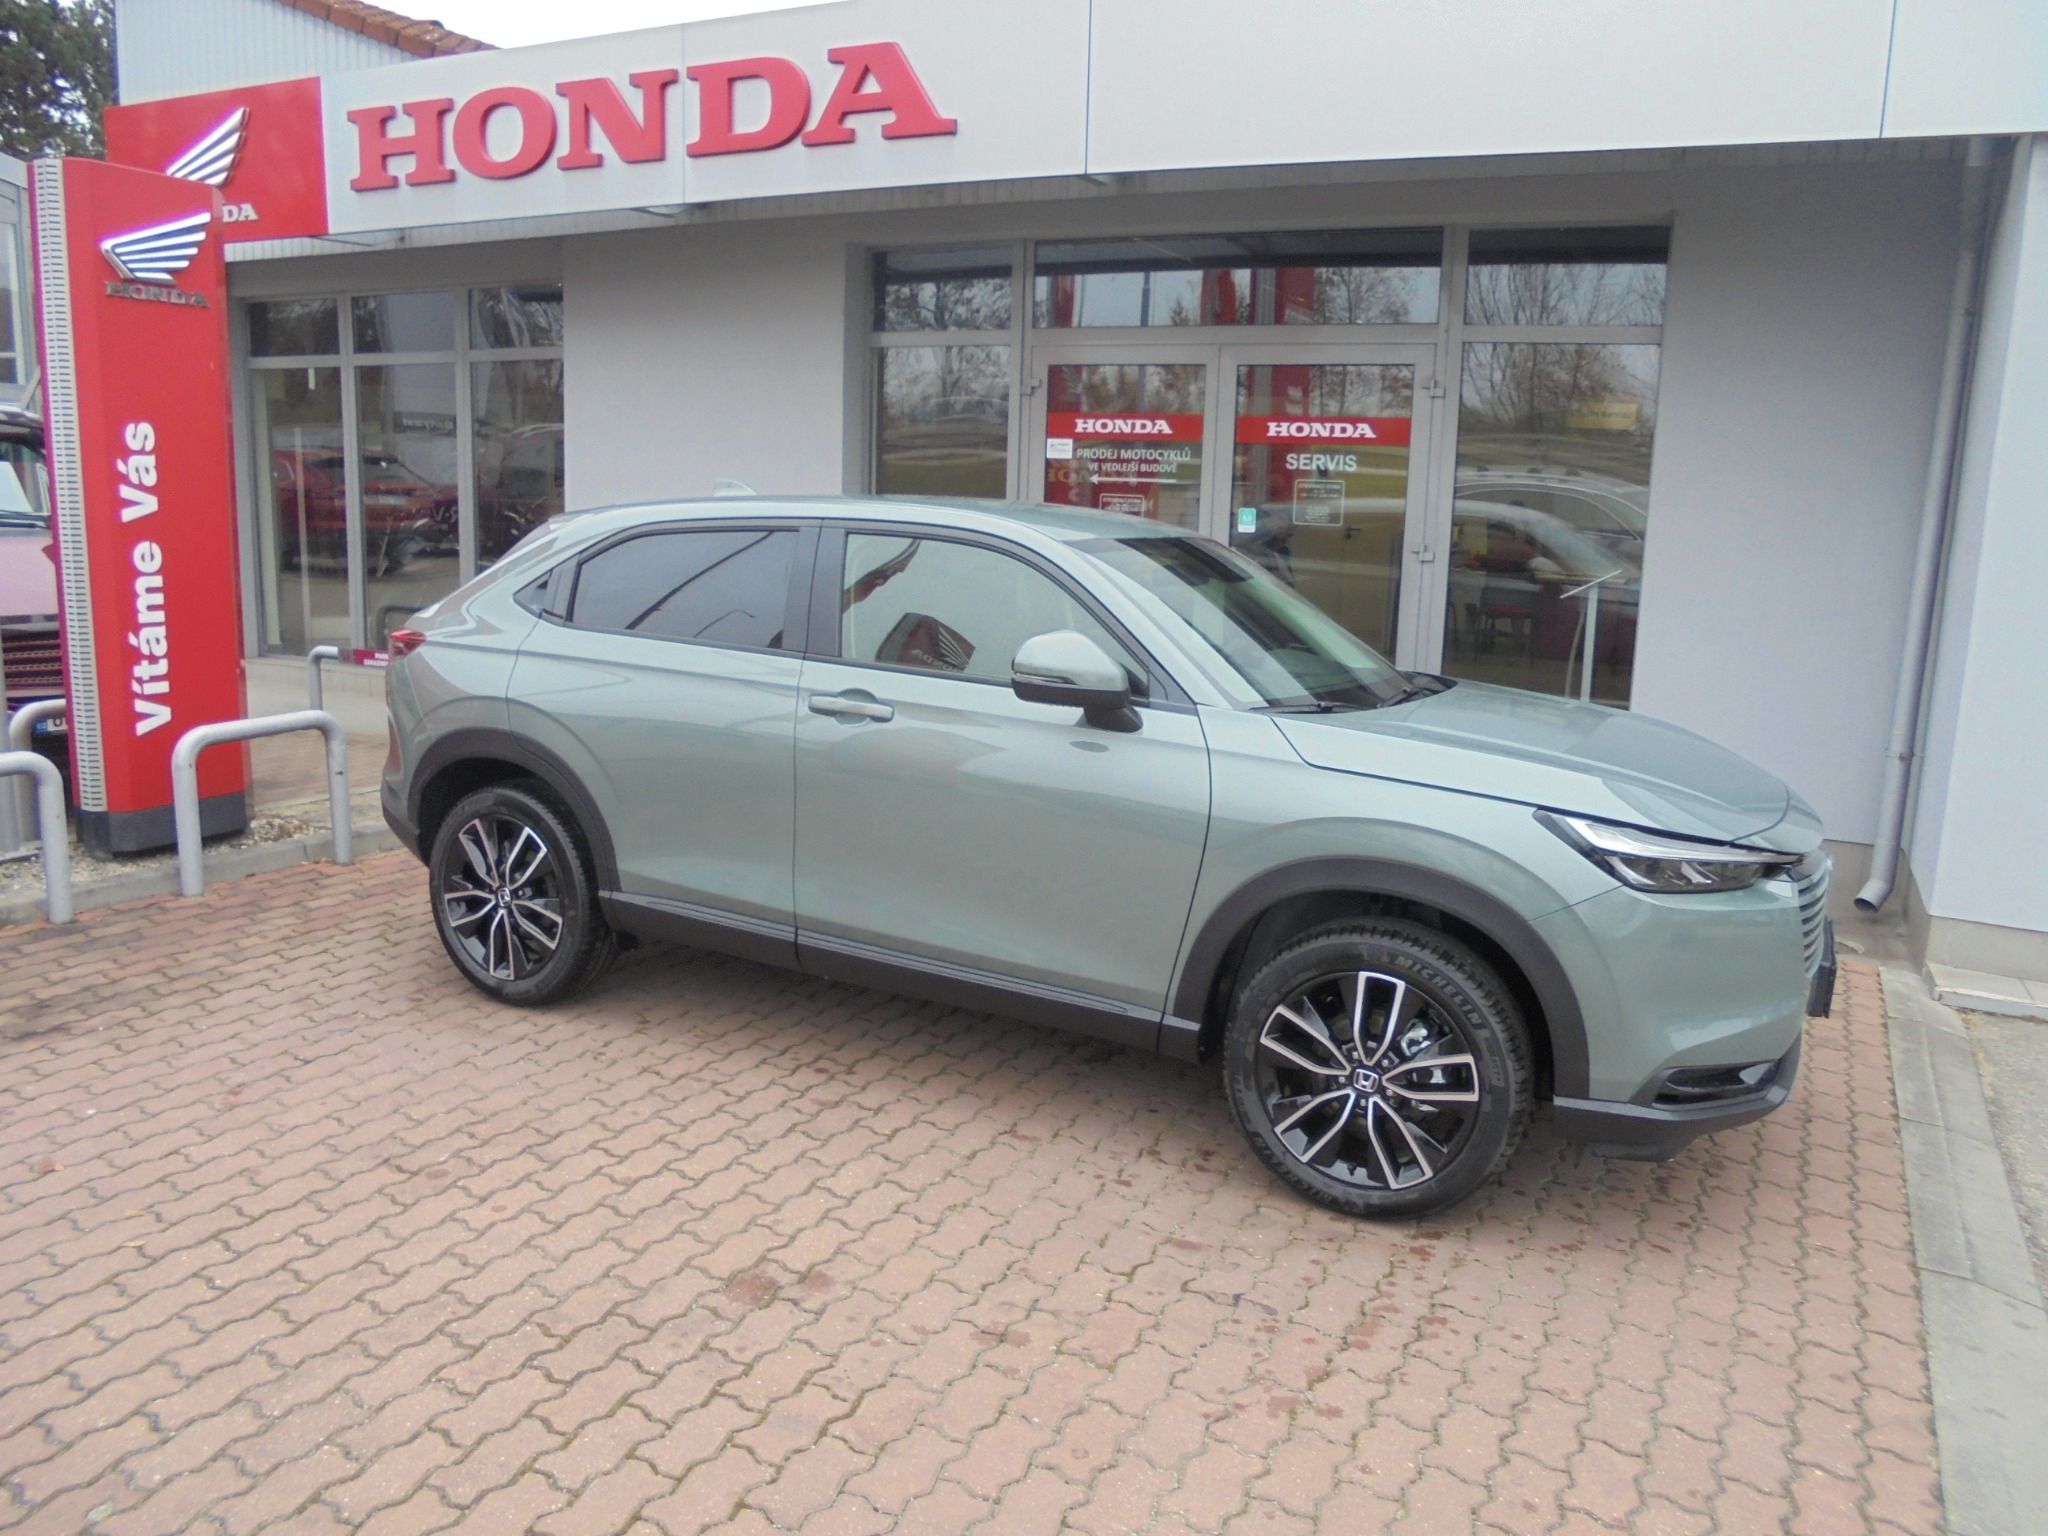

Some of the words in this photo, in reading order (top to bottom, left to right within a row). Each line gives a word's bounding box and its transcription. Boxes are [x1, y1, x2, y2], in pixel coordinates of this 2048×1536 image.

[347, 41, 957, 192] HONDA
[222, 203, 259, 223] DA
[104, 281, 209, 307] HONDA
[1074, 418, 1173, 434] HONDA
[1266, 422, 1376, 438] HONDA
[1076, 448, 1118, 460] PRODEJ
[1120, 446, 1191, 461] MOTOCYKLŮ
[1285, 453, 1358, 472] SERVIS
[117, 421, 159, 523] Vás
[1088, 462, 1099, 471] VE
[1101, 460, 1139, 473] VEDLEJŠÍ
[128, 540, 173, 737] Vítáme
[1394, 955, 1483, 1025] MICHELIN
